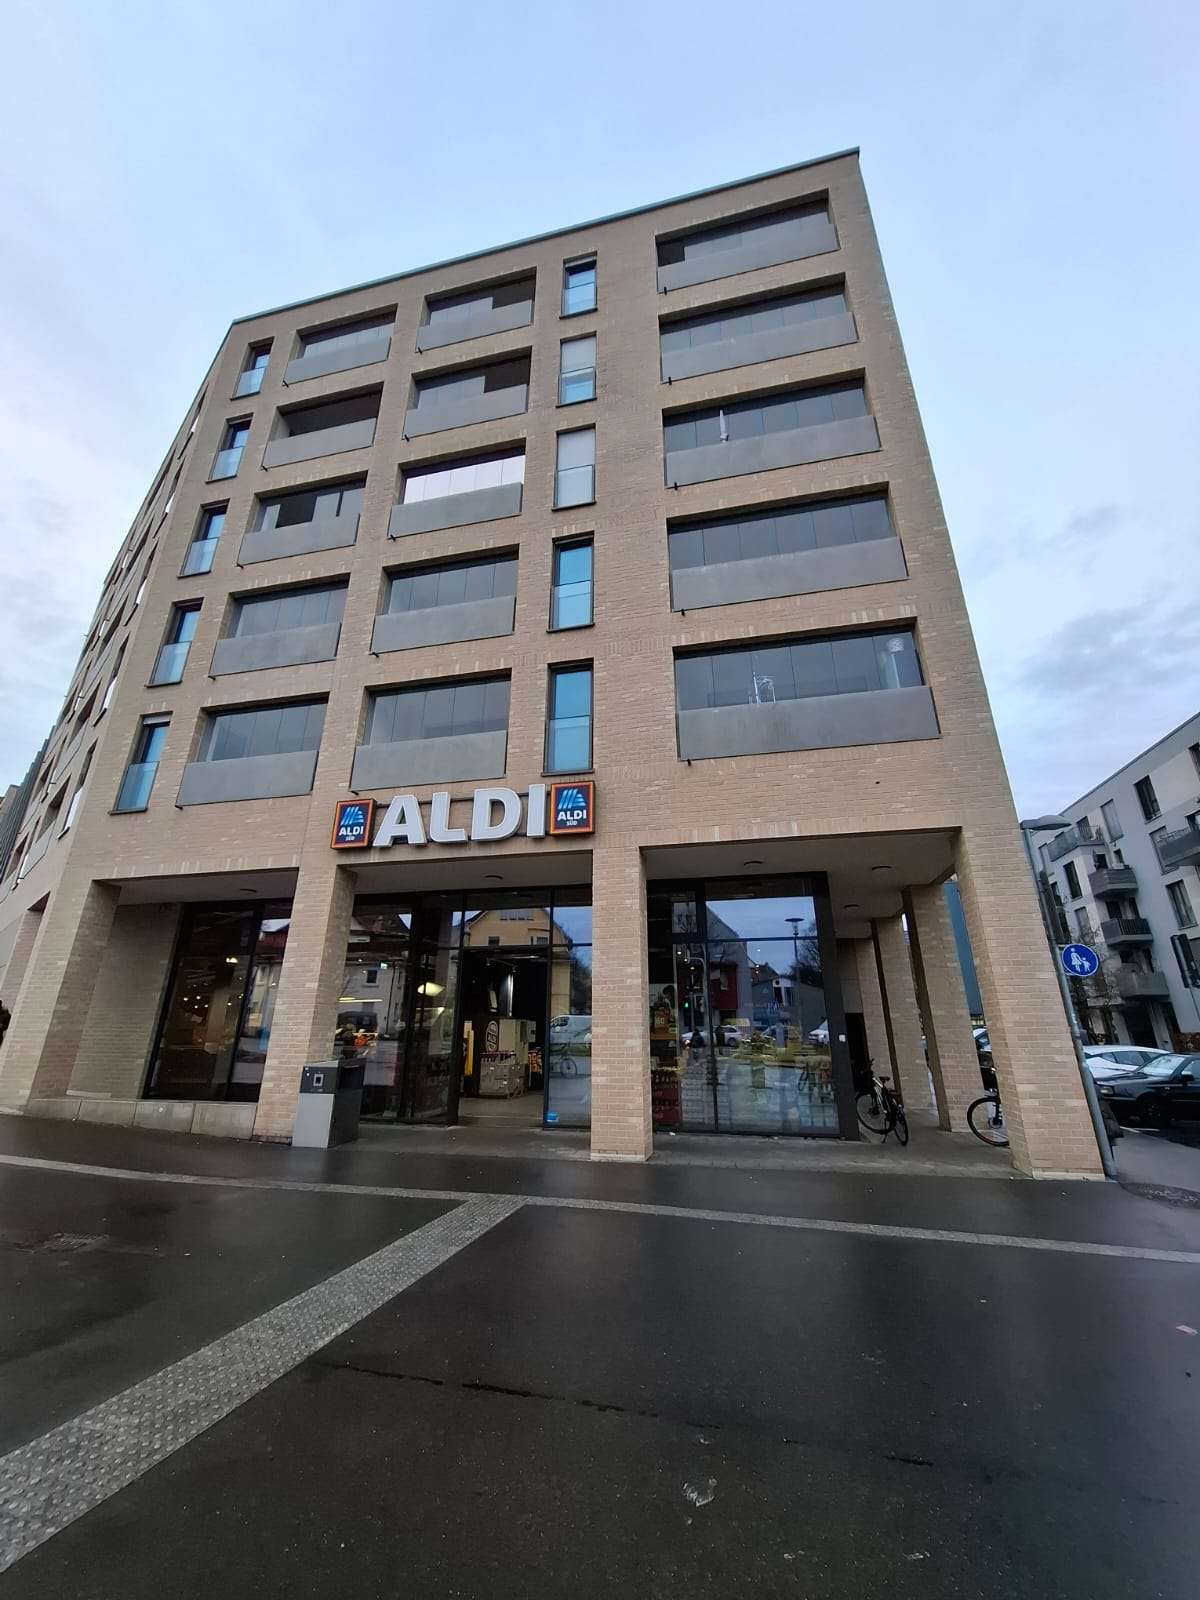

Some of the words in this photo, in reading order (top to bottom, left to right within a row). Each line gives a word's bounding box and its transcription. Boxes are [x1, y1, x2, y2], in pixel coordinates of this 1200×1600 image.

[372, 784, 546, 847] ALDI
[557, 809, 587, 821] ALDI
[338, 825, 364, 836] ALDI
